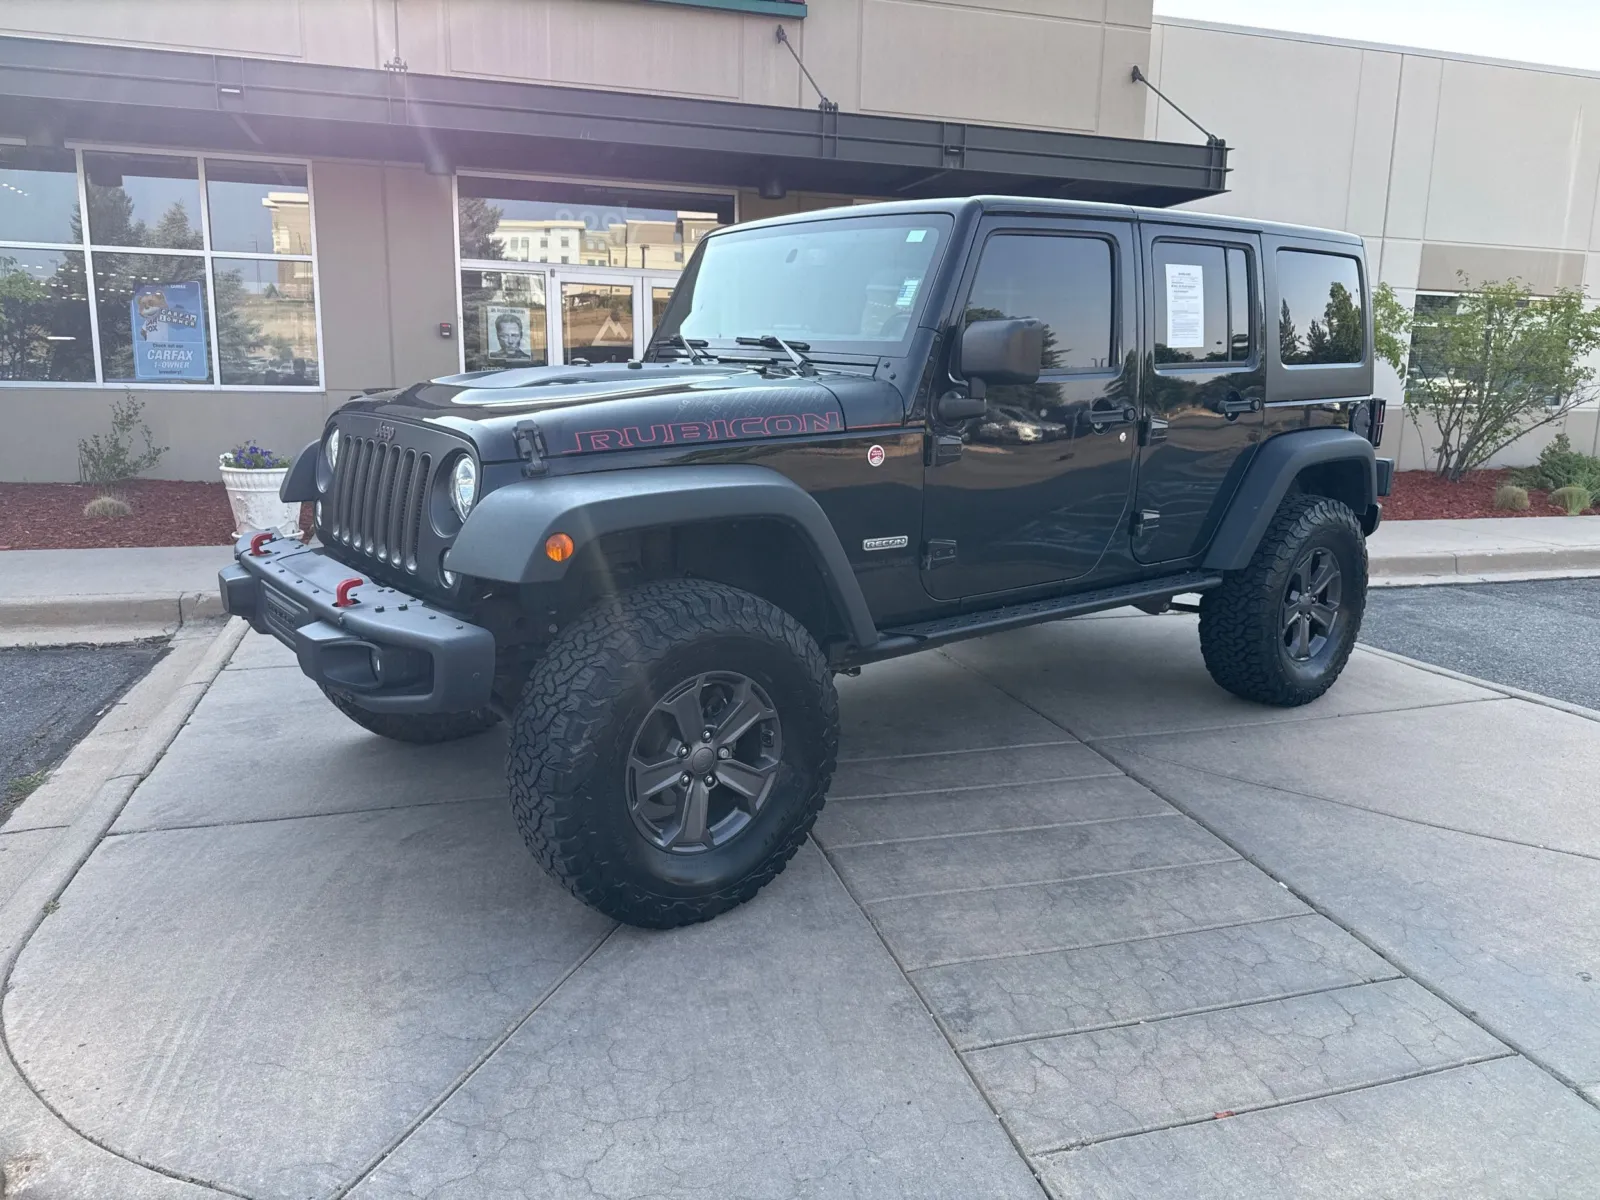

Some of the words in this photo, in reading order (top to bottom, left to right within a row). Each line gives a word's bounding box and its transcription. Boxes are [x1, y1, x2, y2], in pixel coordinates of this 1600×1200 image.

[147, 349, 194, 361] CARFAX
[154, 361, 190, 369] 1-OWNER
[375, 421, 396, 442] Jeep
[574, 411, 841, 452] RUBICON
[866, 538, 905, 548] RECON
